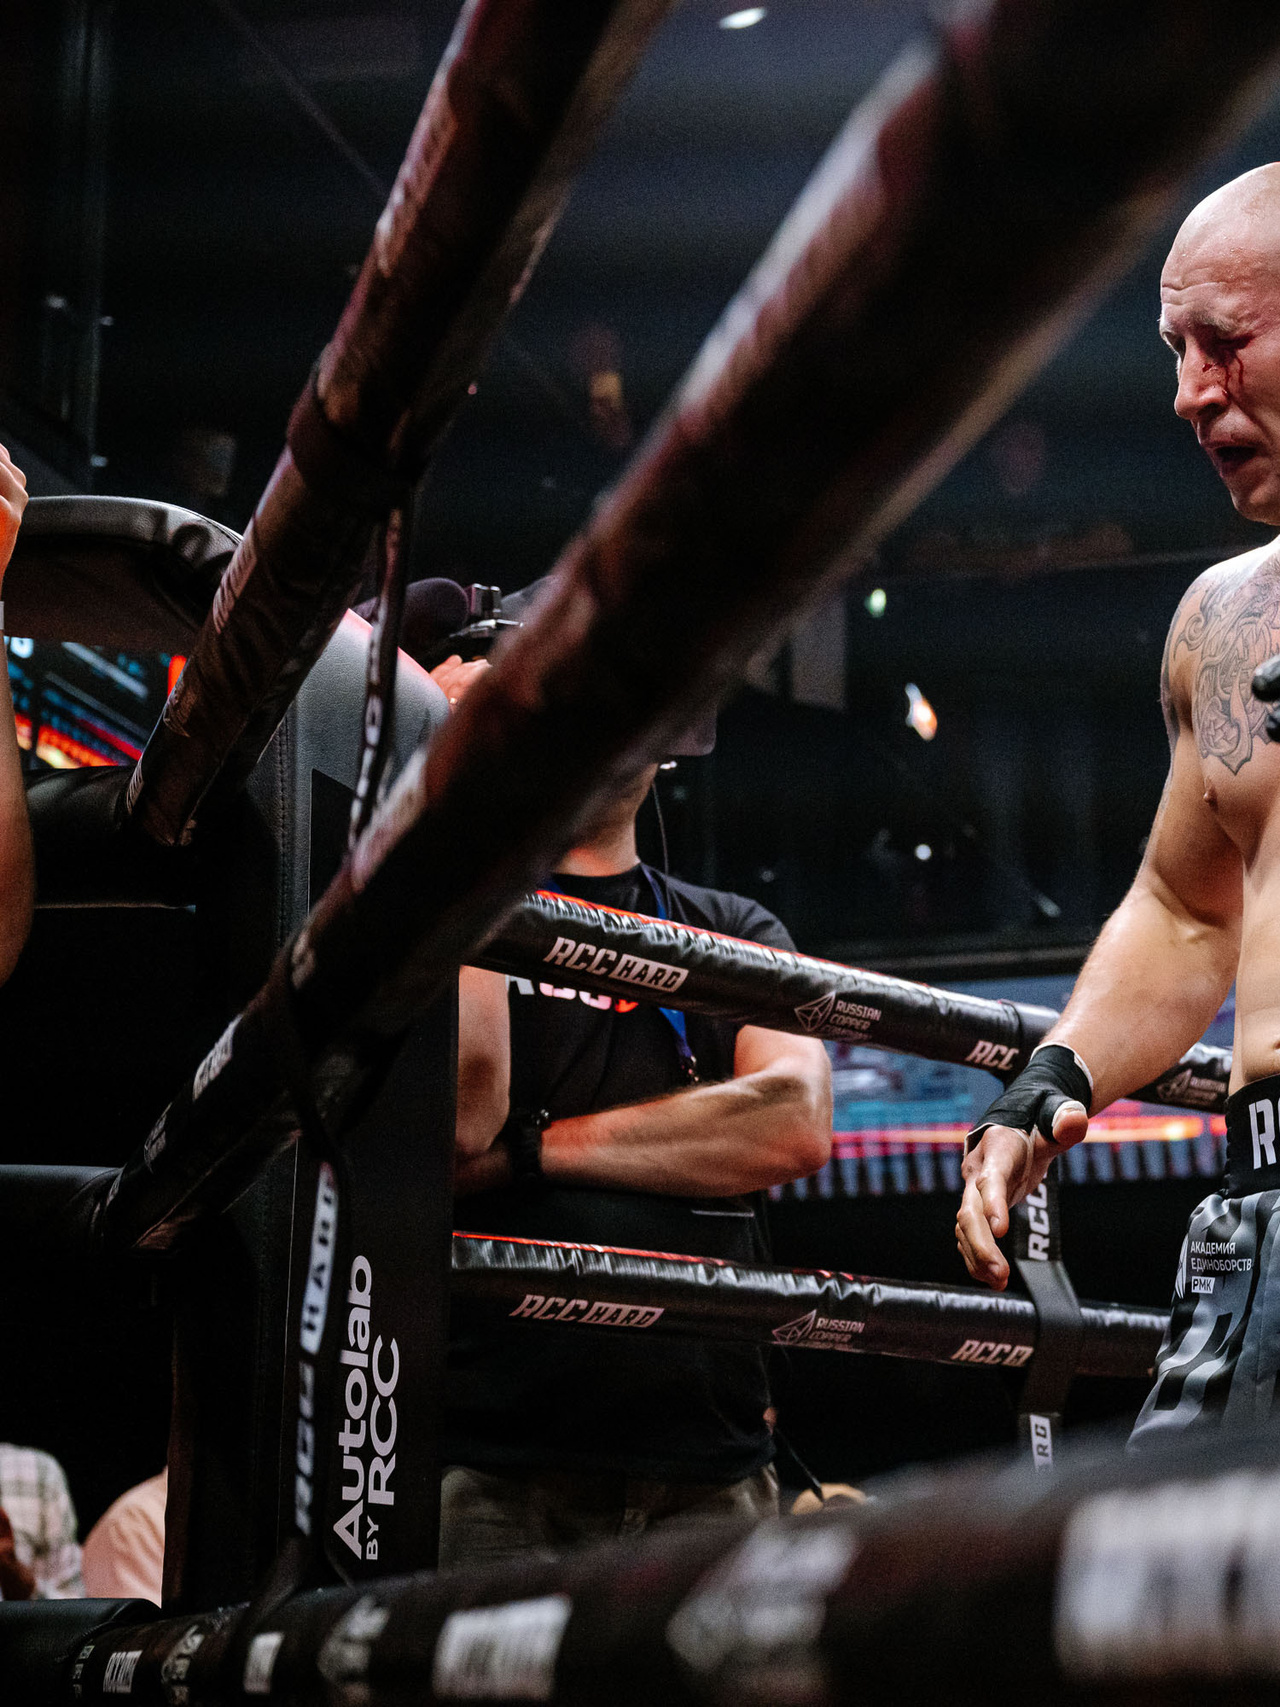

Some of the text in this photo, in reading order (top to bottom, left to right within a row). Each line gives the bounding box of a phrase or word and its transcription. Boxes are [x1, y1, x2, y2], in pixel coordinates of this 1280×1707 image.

[543, 936, 686, 991] RCC HARD
[829, 1013, 871, 1031] COPPER
[835, 1000, 882, 1021] RUSSIAN
[1190, 1241, 1237, 1256] АКАДЕМИЯ
[1190, 1257, 1253, 1273] ЕДИНОБОРСТВ
[508, 1294, 660, 1326] RCC HARD
[815, 1317, 866, 1333] RUSSIAN
[950, 1339, 1013, 1365] RCC
[333, 1255, 373, 1560] Autolab
[365, 1334, 400, 1561] BY RCC
[1033, 1422, 1051, 1464] RD
